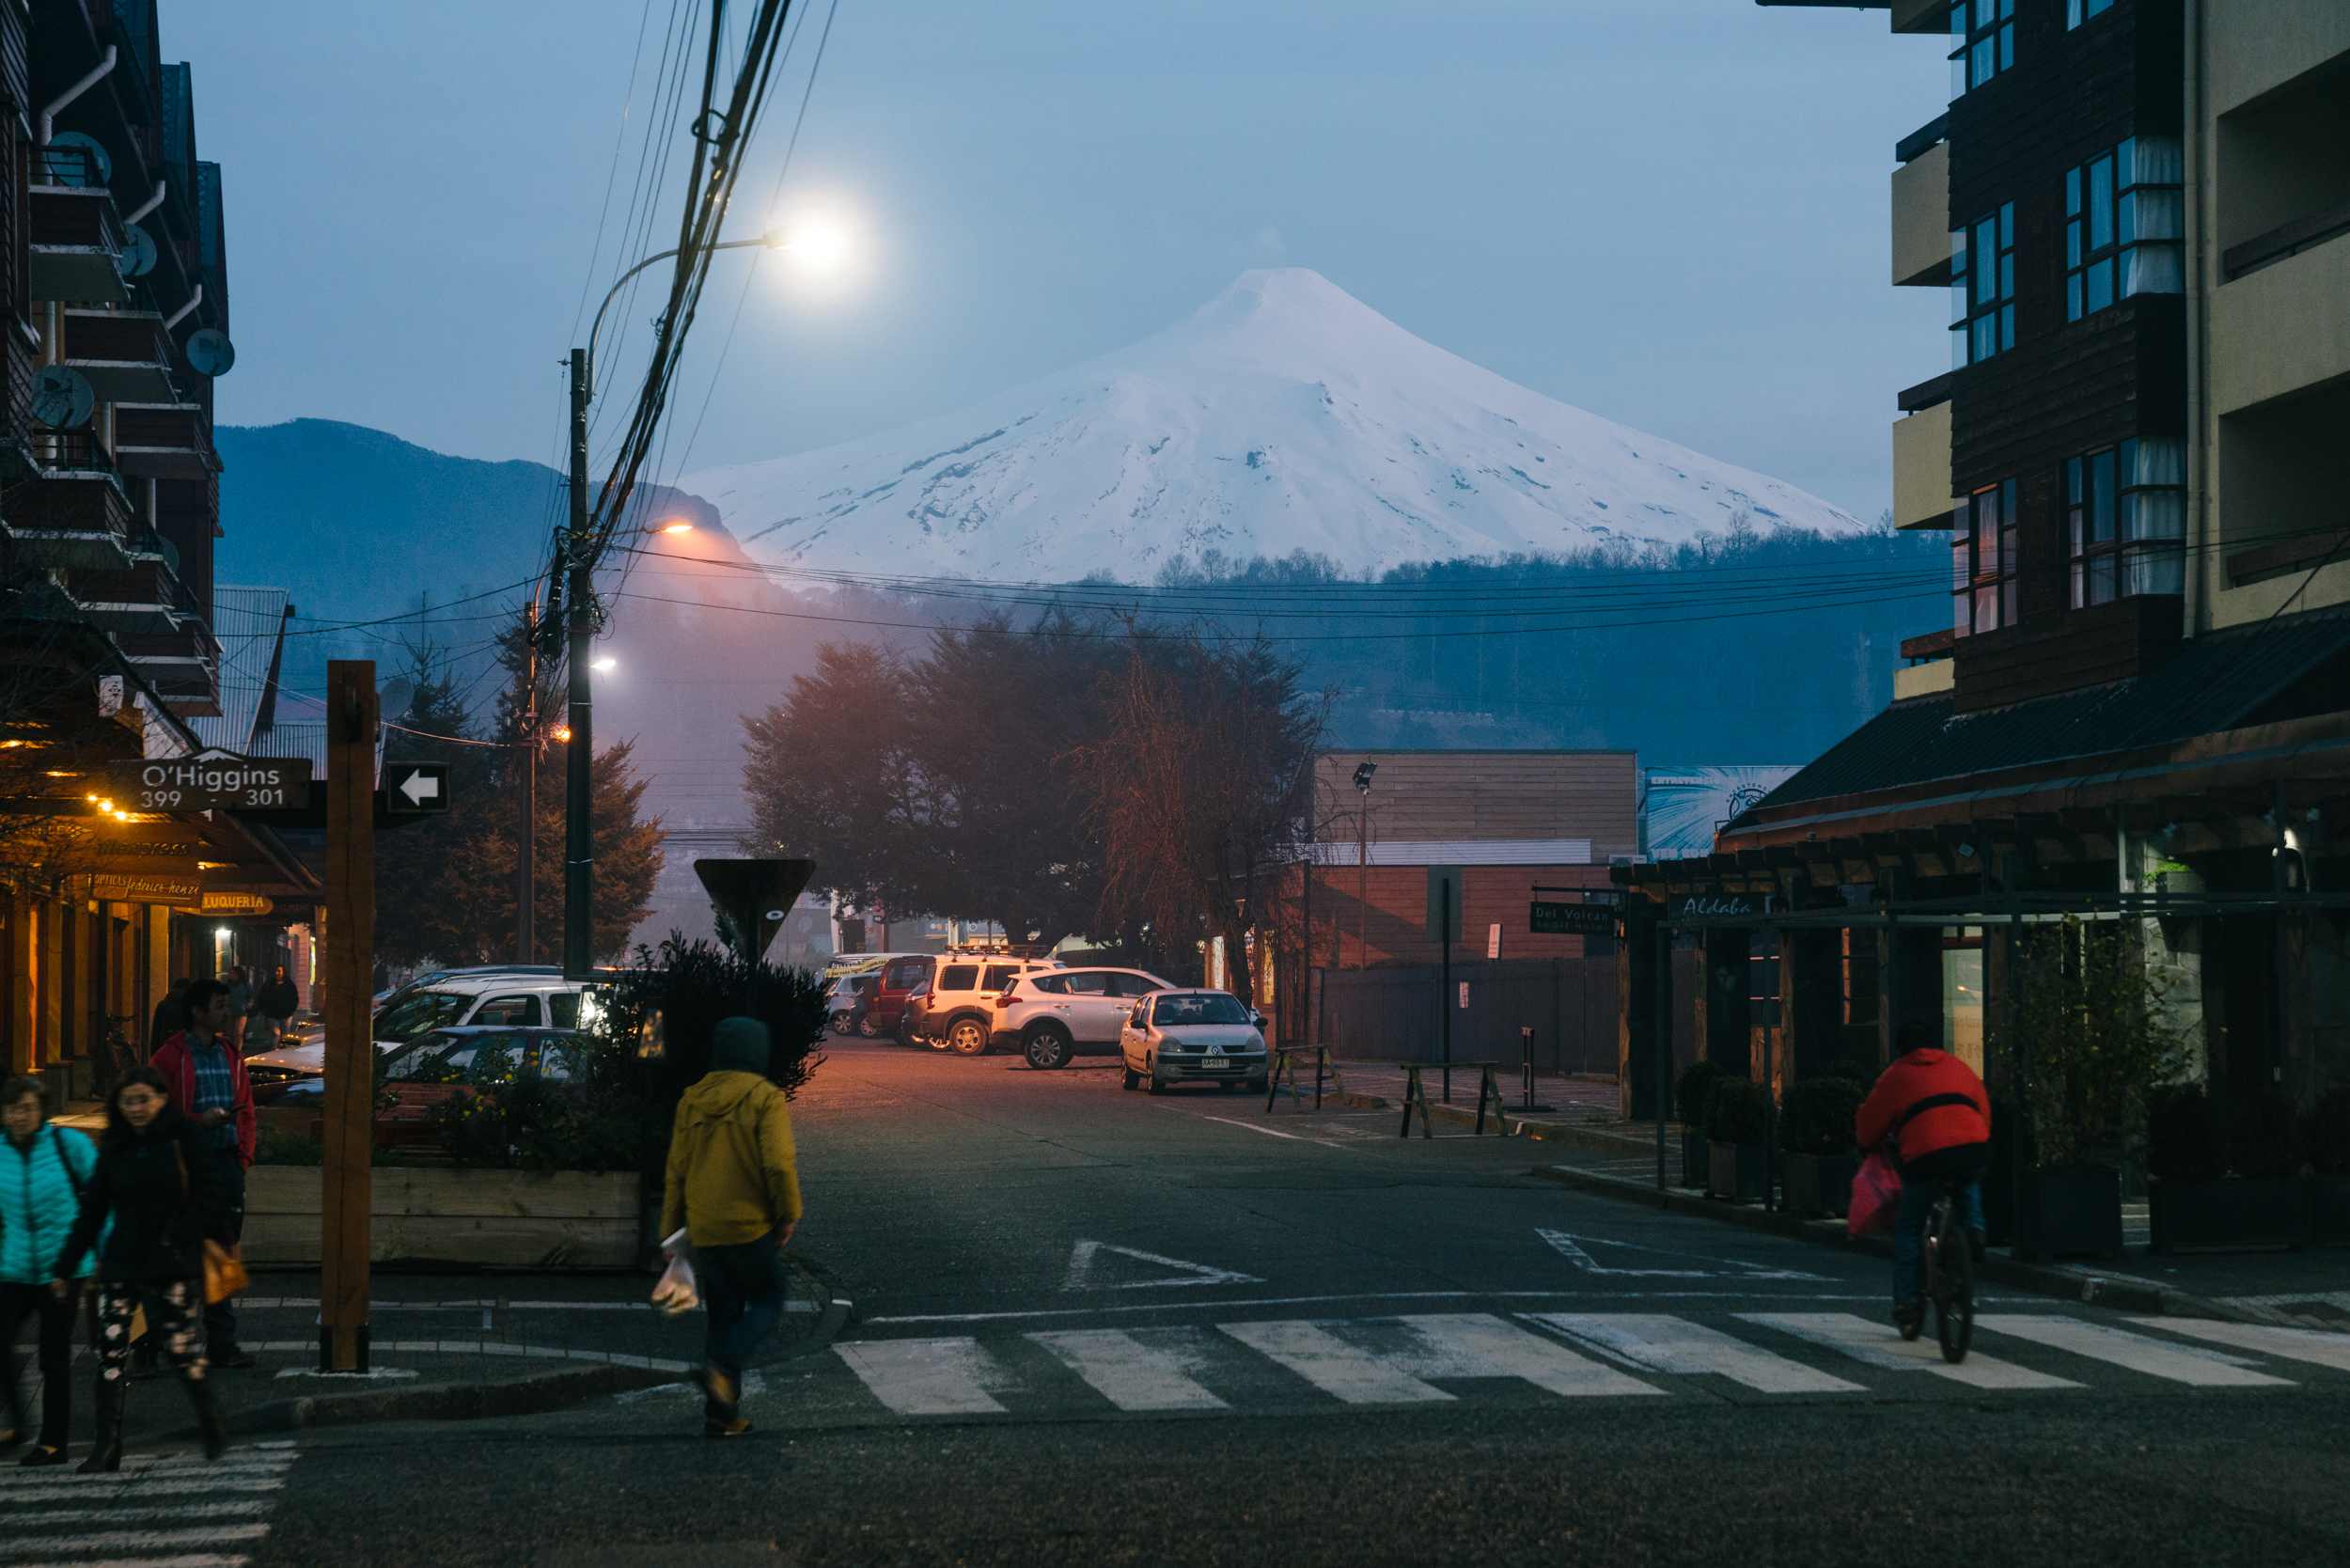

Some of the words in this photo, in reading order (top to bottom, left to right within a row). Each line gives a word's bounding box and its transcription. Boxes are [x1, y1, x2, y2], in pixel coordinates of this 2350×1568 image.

[142, 764, 280, 792] O'Higgins
[140, 790, 181, 808] 399
[245, 789, 284, 806] 301
[95, 874, 127, 886] OPTICAS
[202, 896, 265, 908] LUQUERIA
[1683, 897, 1751, 916] Aldaba
[1536, 907, 1557, 918] Del
[1535, 920, 1569, 929] Apart
[1575, 922, 1607, 931] Hotel
